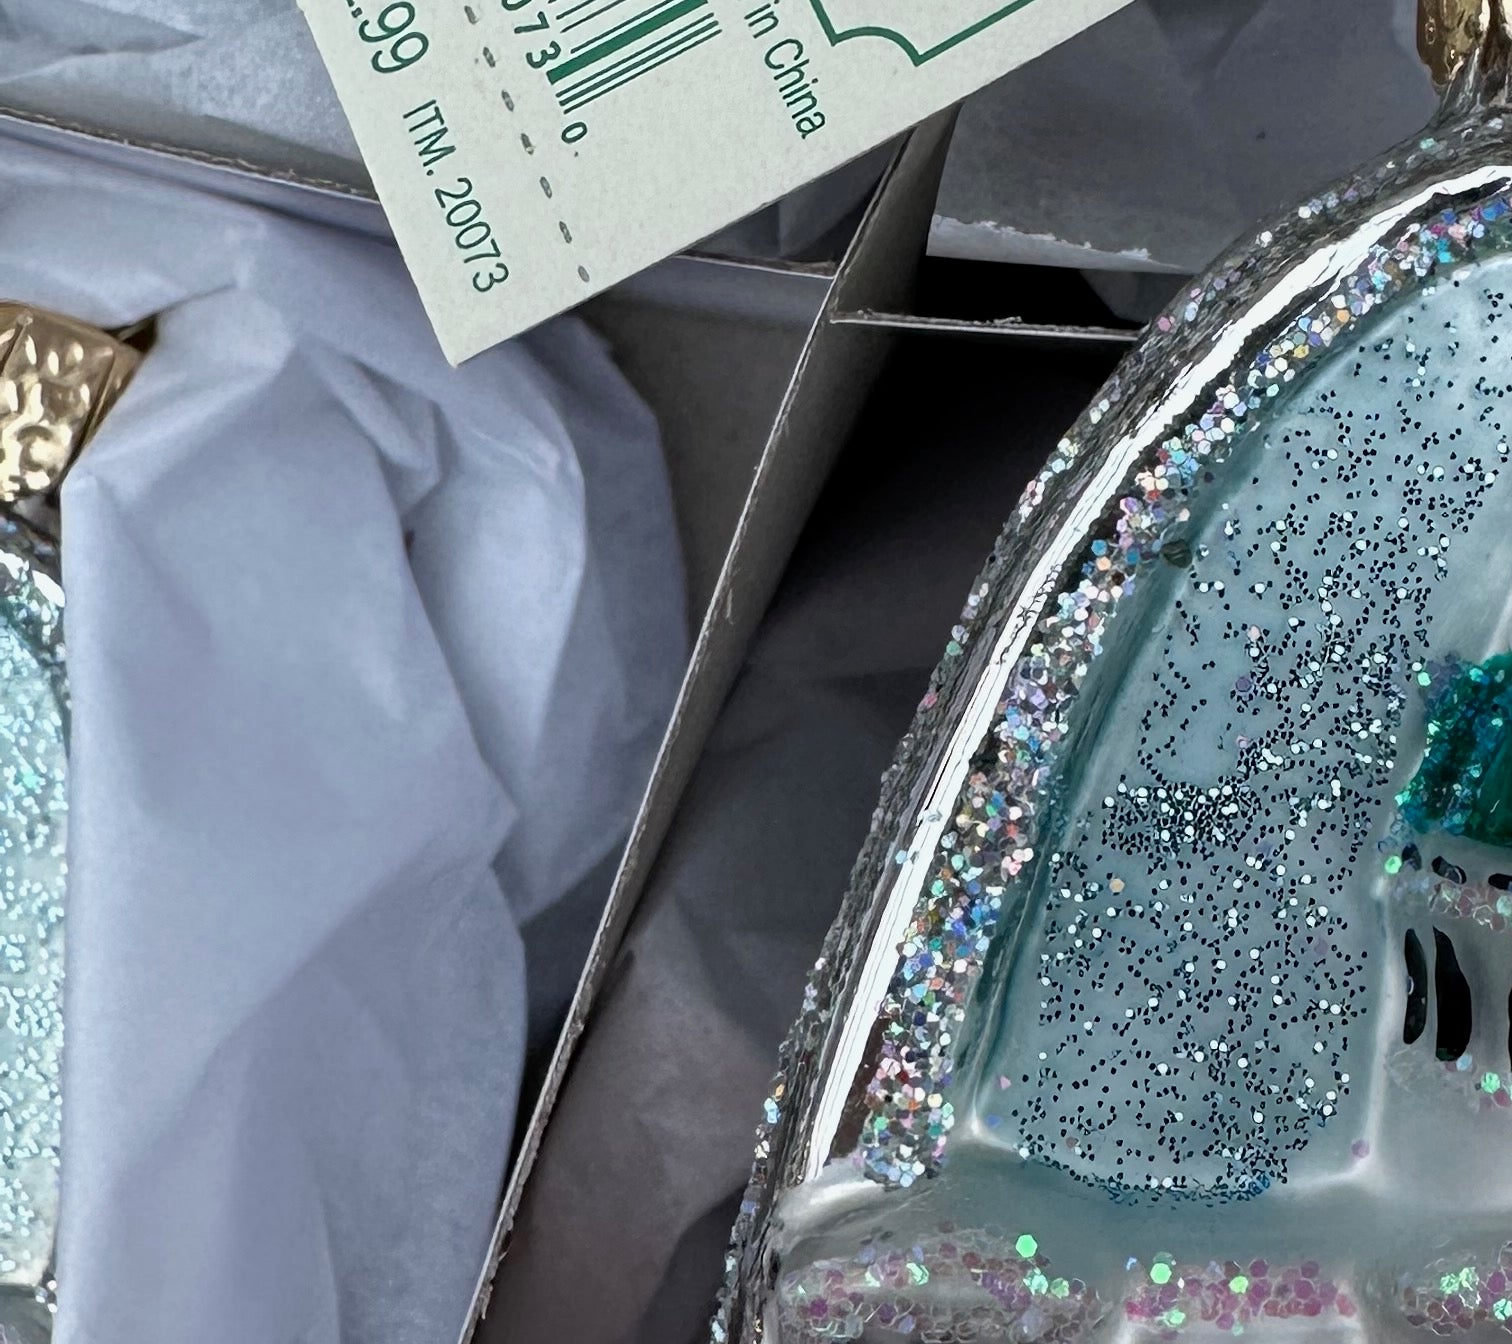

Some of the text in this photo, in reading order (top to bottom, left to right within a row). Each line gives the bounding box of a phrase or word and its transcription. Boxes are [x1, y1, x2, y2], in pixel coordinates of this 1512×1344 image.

[762, 37, 826, 140] China
[401, 98, 457, 177] ITM.
[433, 176, 509, 293] 20073
